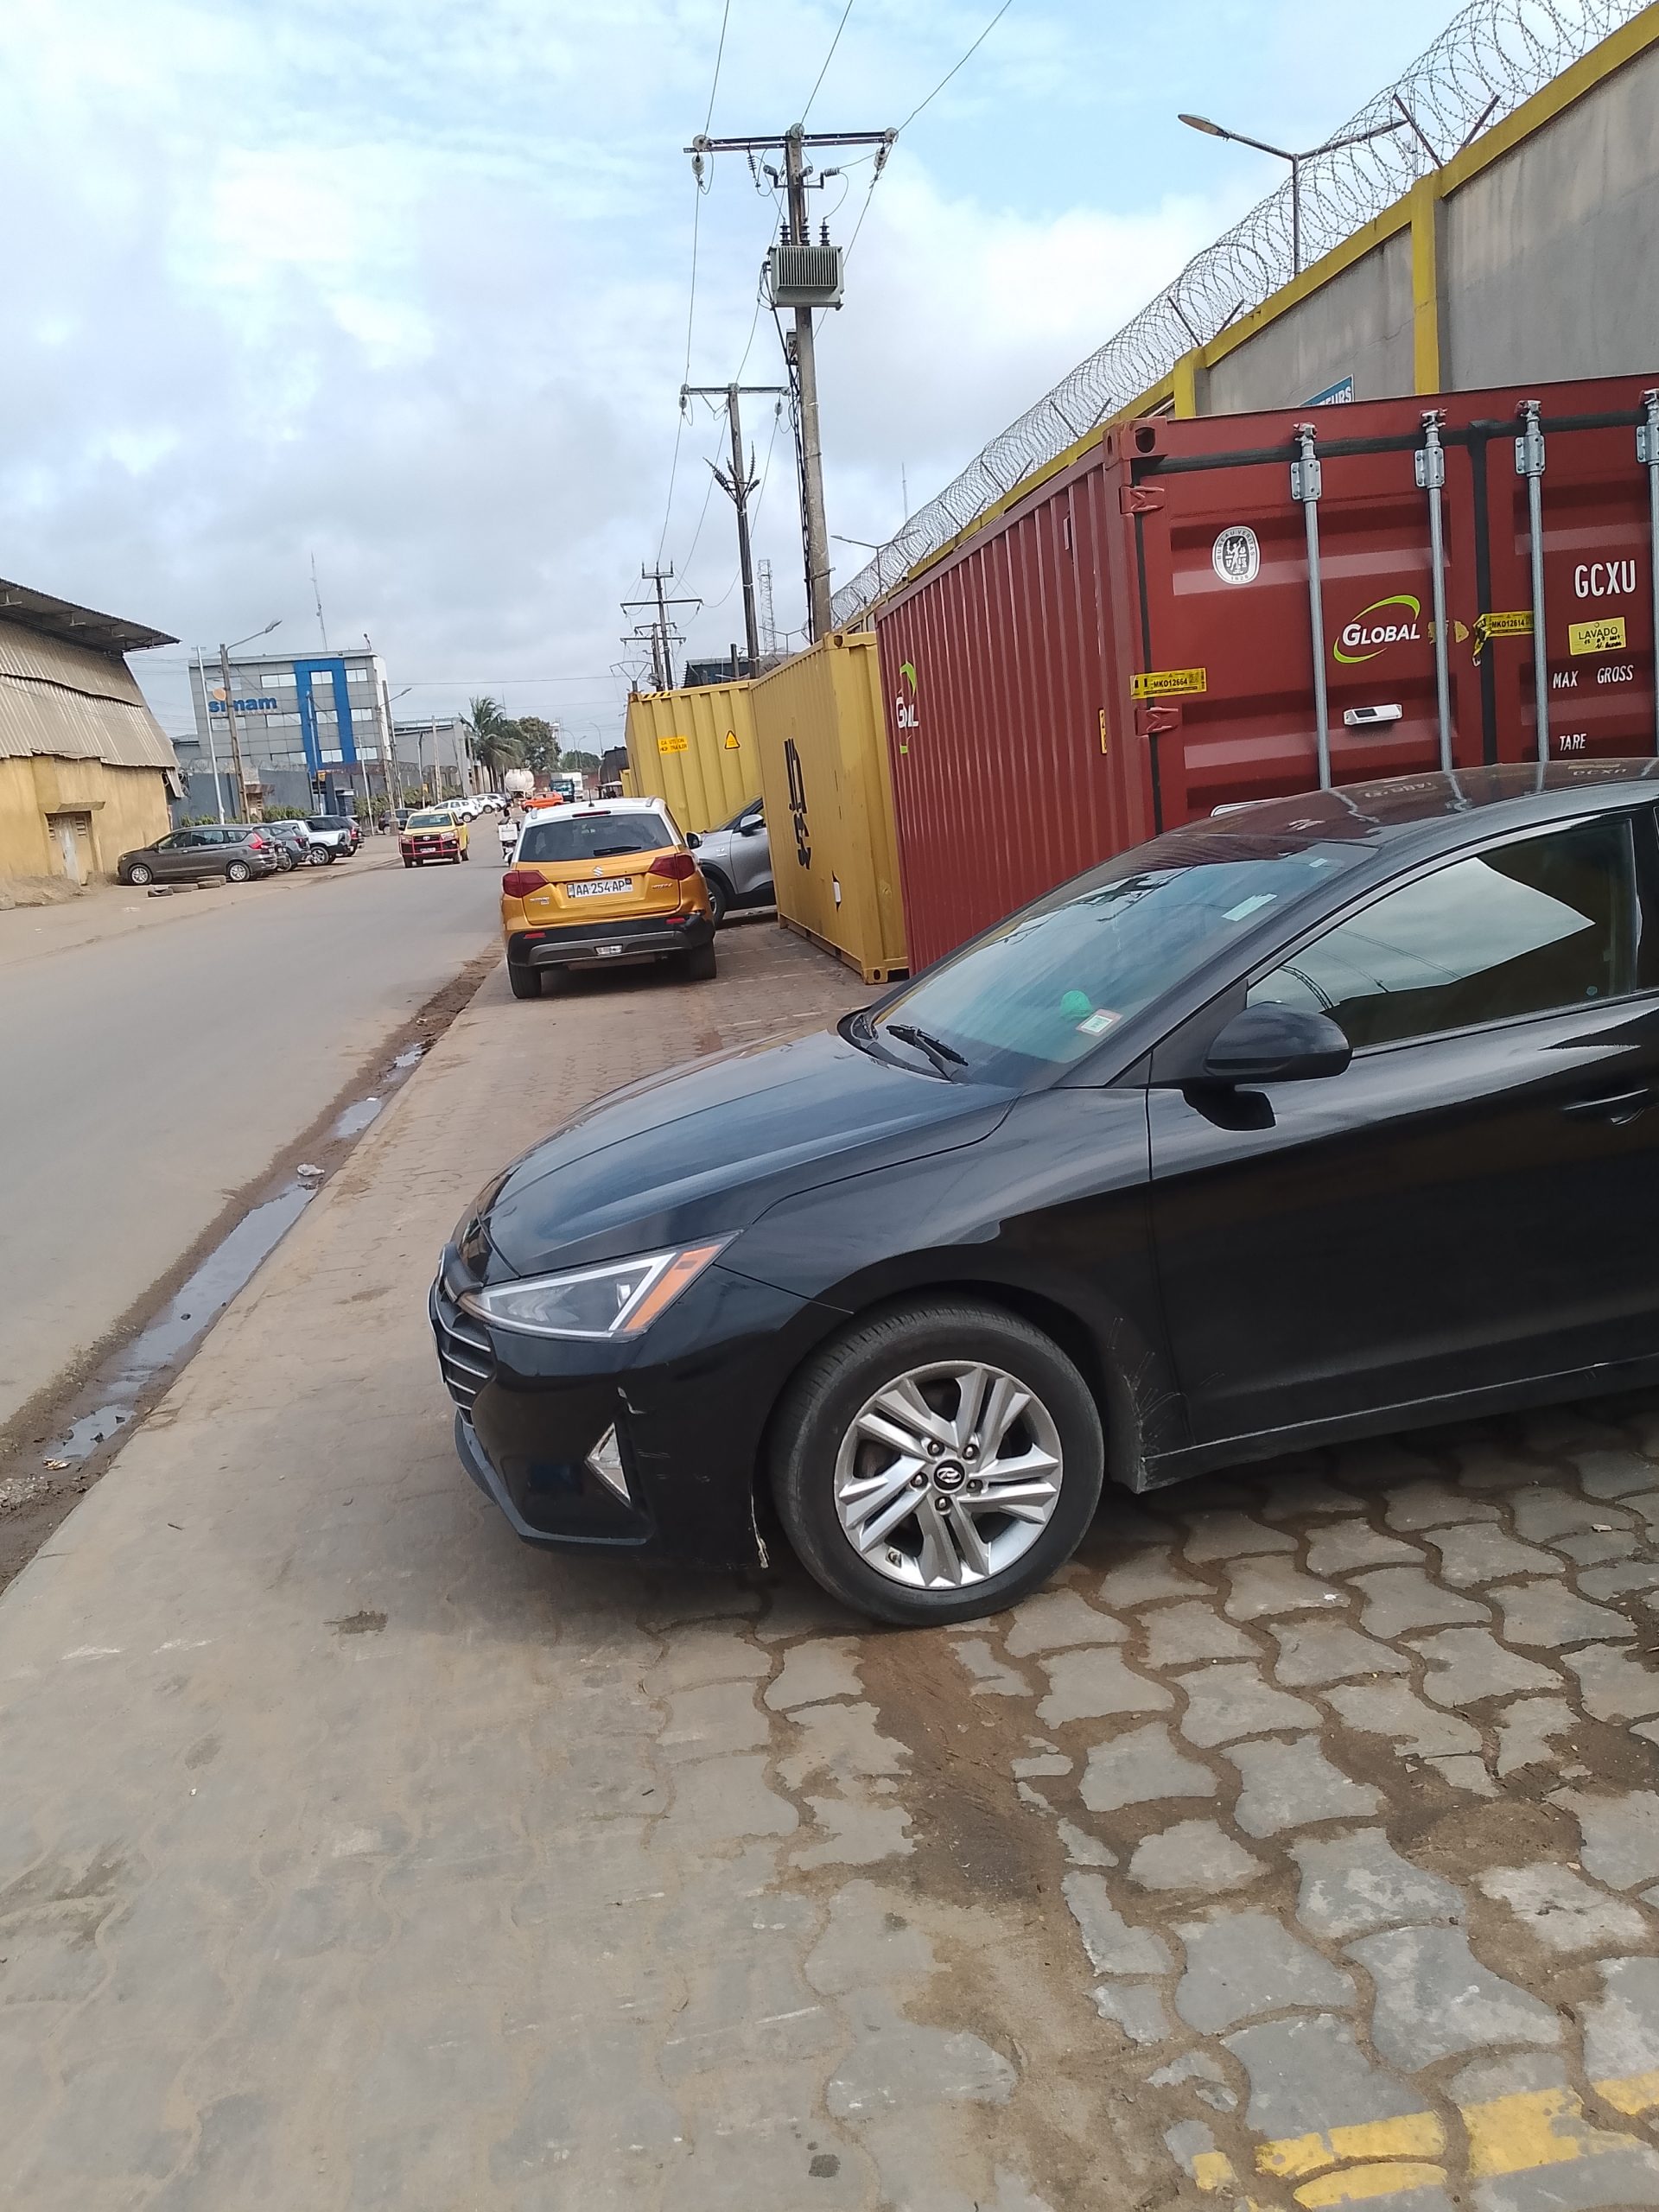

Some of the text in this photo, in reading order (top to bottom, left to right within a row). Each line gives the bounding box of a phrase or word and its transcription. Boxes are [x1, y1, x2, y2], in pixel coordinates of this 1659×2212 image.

[1217, 529, 1255, 560] BUREAU VERITAS
[1574, 559, 1636, 598] GCXU
[1342, 622, 1421, 646] GLOBAL
[1578, 626, 1618, 640] LAVADO
[1553, 664, 1634, 689] MAX GROSS
[1559, 733, 1587, 751] TARE
